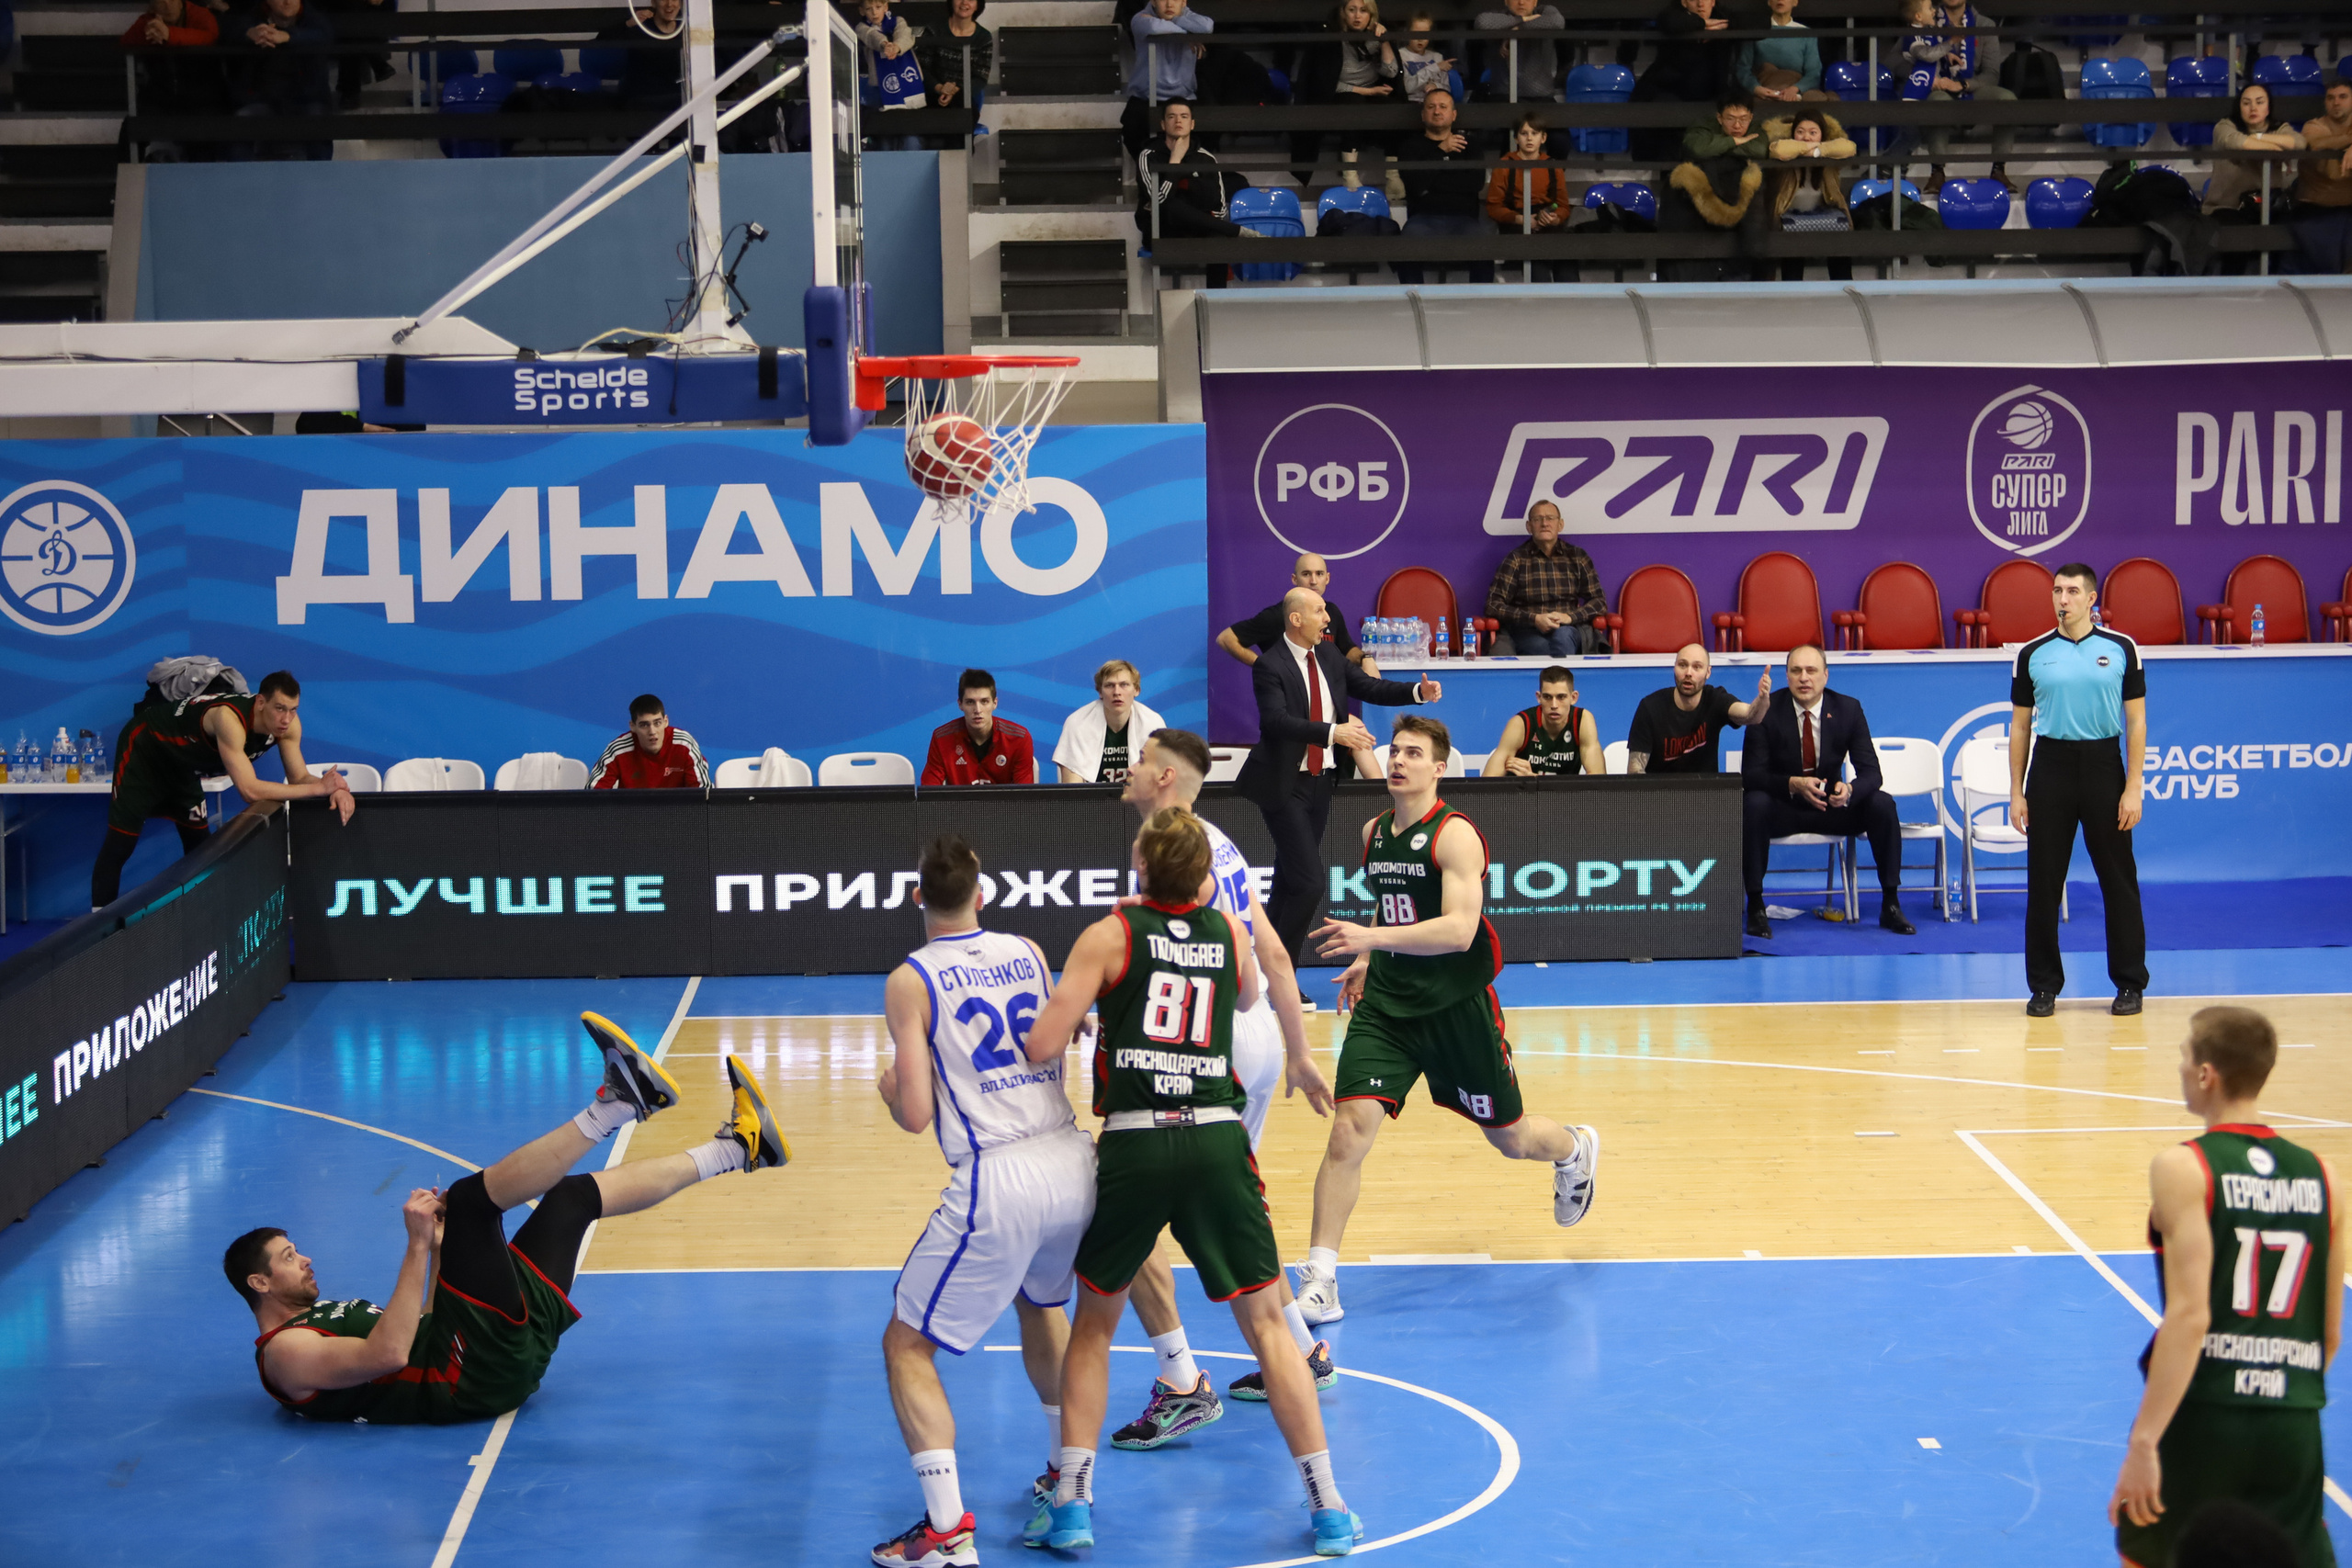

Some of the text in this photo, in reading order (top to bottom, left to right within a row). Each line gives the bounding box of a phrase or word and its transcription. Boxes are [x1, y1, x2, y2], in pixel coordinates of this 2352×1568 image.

[514, 367, 649, 389] Schelde
[514, 388, 650, 416] Sports
[1500, 431, 1869, 520] PARI
[2003, 455, 2053, 468] PARI
[2175, 410, 2343, 526] PARI
[1276, 461, 1390, 502] РФБ
[2007, 511, 2049, 536] ЛИГА
[276, 476, 1109, 626] ДИНАМО
[2141, 773, 2240, 800] КЛУБ
[1368, 862, 1426, 877] ЛОКОМОТИВ
[325, 875, 666, 918] ЛУЧШЕЕ
[1382, 894, 1417, 925] 88
[938, 957, 1035, 991] СТУЛЕНКОВ
[1143, 971, 1215, 1047] 81
[53, 950, 219, 1106] ПРИЛОЖЕНИЕ
[955, 991, 1039, 1073] 26
[1115, 1048, 1227, 1077] КРАСНОДАРСКИЙ
[1154, 1074, 1193, 1095] КРАЙ
[2222, 1174, 2323, 1214] ГЕРАСИМОВ
[2232, 1227, 2312, 1318] 17
[2234, 1369, 2286, 1398] КРАЙ
